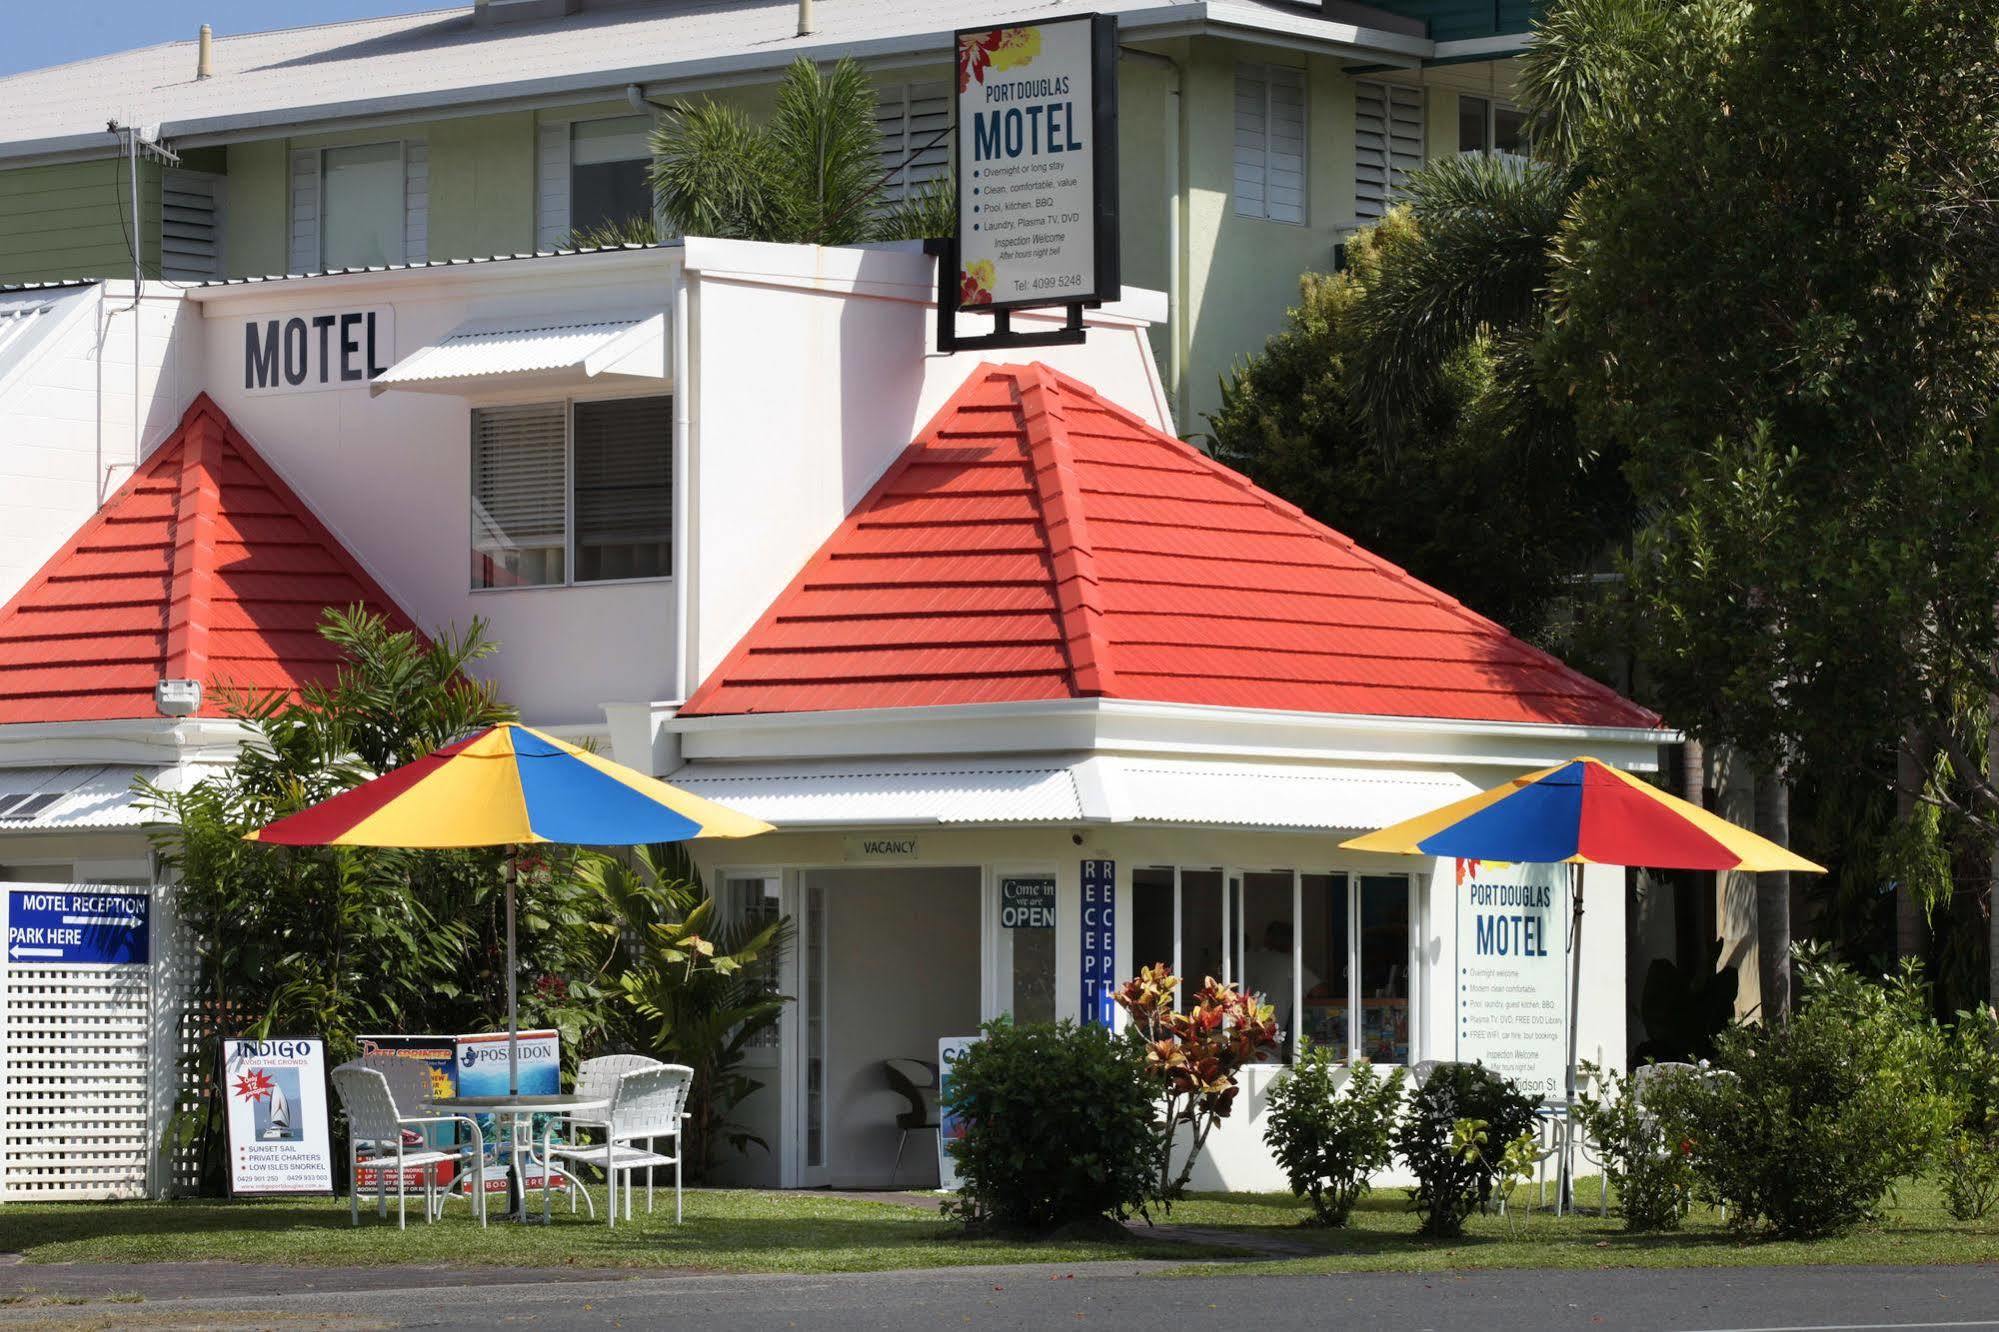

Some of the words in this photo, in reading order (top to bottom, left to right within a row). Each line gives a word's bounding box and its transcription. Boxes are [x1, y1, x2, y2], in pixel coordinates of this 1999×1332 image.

[986, 83, 1015, 103] PORT
[1017, 76, 1069, 99] DOUGLAS
[974, 101, 1082, 162] MOTEL
[983, 165, 1020, 177] Overnight
[1021, 165, 1029, 174] or
[1031, 163, 1047, 173] long
[1048, 161, 1064, 171] stay
[1057, 178, 1077, 188] value
[984, 203, 1002, 214] Pool,
[1035, 198, 1054, 208] BBQ
[984, 221, 1015, 233] Laundry,
[1018, 217, 1045, 228] Plasma
[1061, 213, 1079, 223] DVD
[994, 236, 1030, 249] Inspection
[1032, 233, 1065, 245] Welcome
[1000, 251, 1014, 260] After
[1015, 251, 1032, 259] hours
[1033, 249, 1048, 260] night
[1048, 247, 1060, 256] bell
[1014, 280, 1030, 292] Tel:
[1032, 277, 1056, 290] 4099
[1058, 274, 1081, 288] 5248
[245, 312, 388, 389] MOTEL
[864, 841, 915, 854] VACANCY
[1004, 880, 1039, 898] Come
[1043, 881, 1054, 896] in
[1470, 884, 1498, 906] PORT
[1500, 885, 1550, 908] DOUGLAS
[23, 895, 69, 912] MOTEL
[73, 896, 146, 914] RECEPTION
[1002, 907, 1055, 927] OPEN
[9, 927, 44, 944] PARK
[47, 928, 82, 945] HERE
[1085, 861, 1096, 1021] RECEPTI
[1476, 914, 1547, 957] MOTEL
[1102, 861, 1113, 1040] RECEPTI
[1470, 968, 1495, 978] Overnight
[1496, 969, 1520, 977] welcome
[1542, 1000, 1554, 1009] BBQ
[1515, 1015, 1530, 1024] FREE
[1532, 1016, 1544, 1025] DVD
[1470, 1031, 1485, 1039] FREE
[237, 1041, 311, 1059] INDIGO
[480, 1045, 551, 1061] POSIDON
[1487, 1050, 1513, 1060] Inspection
[1514, 1049, 1539, 1059] Welcome
[1546, 1077, 1556, 1091] St
[248, 1145, 278, 1153] SUNSET
[267, 1163, 289, 1171] ISLES
[290, 1163, 326, 1171] SNORKEL
[485, 1181, 507, 1189] BOO
[525, 1178, 543, 1186] ERE
